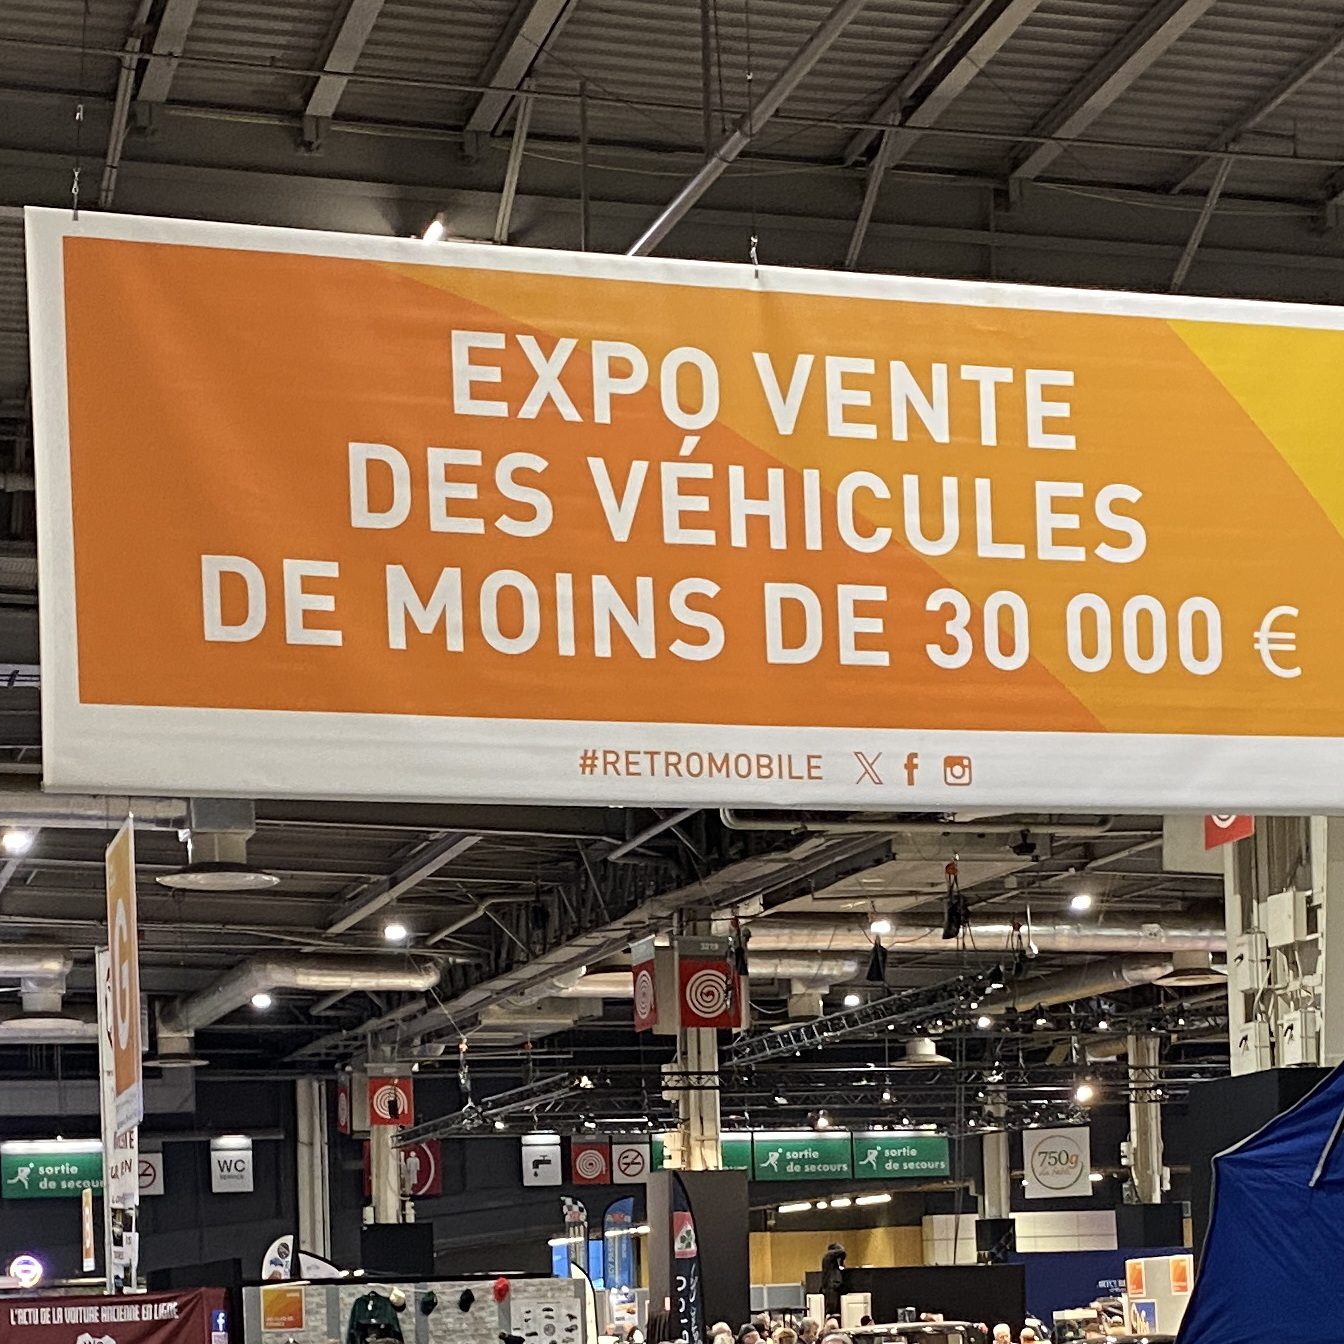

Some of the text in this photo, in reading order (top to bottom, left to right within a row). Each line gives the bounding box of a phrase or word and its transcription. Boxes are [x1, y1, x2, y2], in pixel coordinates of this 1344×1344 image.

[450, 328, 1078, 452] EXPO VENTE
[347, 437, 1148, 565] DES VÉHICULES
[200, 553, 1303, 680] DE MOINS DE 30 000 €
[578, 748, 824, 781] #RETROMOBILE
[785, 1148, 819, 1159] sortie
[884, 1146, 917, 1157] sortie
[217, 1159, 246, 1172] WC
[884, 1159, 946, 1170] de secours
[1038, 1149, 1079, 1170] 750g
[38, 1164, 78, 1175] sortie
[785, 1161, 848, 1173] de secours
[38, 1178, 104, 1190] de secou
[39, 1307, 51, 1325] DE
[52, 1306, 64, 1325] LA
[64, 1305, 100, 1324] VOITURE
